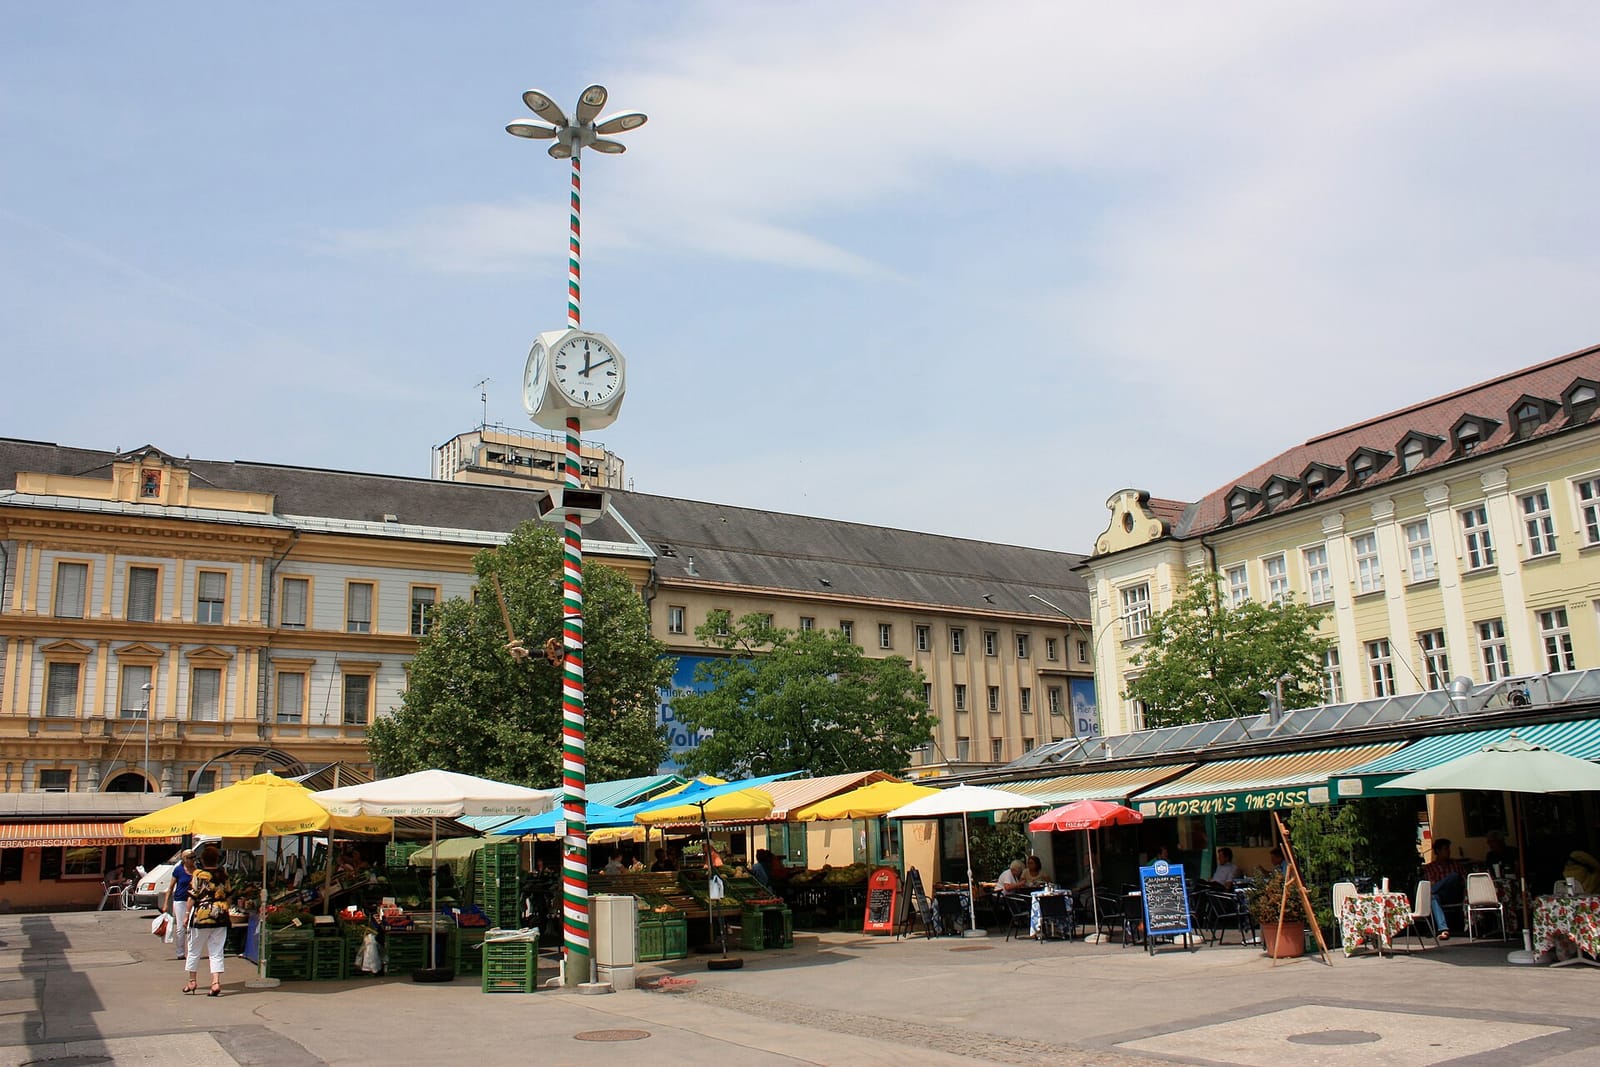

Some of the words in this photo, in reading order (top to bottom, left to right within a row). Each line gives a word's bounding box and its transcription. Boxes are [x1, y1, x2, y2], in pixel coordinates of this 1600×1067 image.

[1078, 718, 1098, 734] Die
[1157, 796, 1237, 818] GUDRUN'S
[1245, 790, 1308, 809] IMBISS
[87, 837, 166, 846] STROMBERGER
